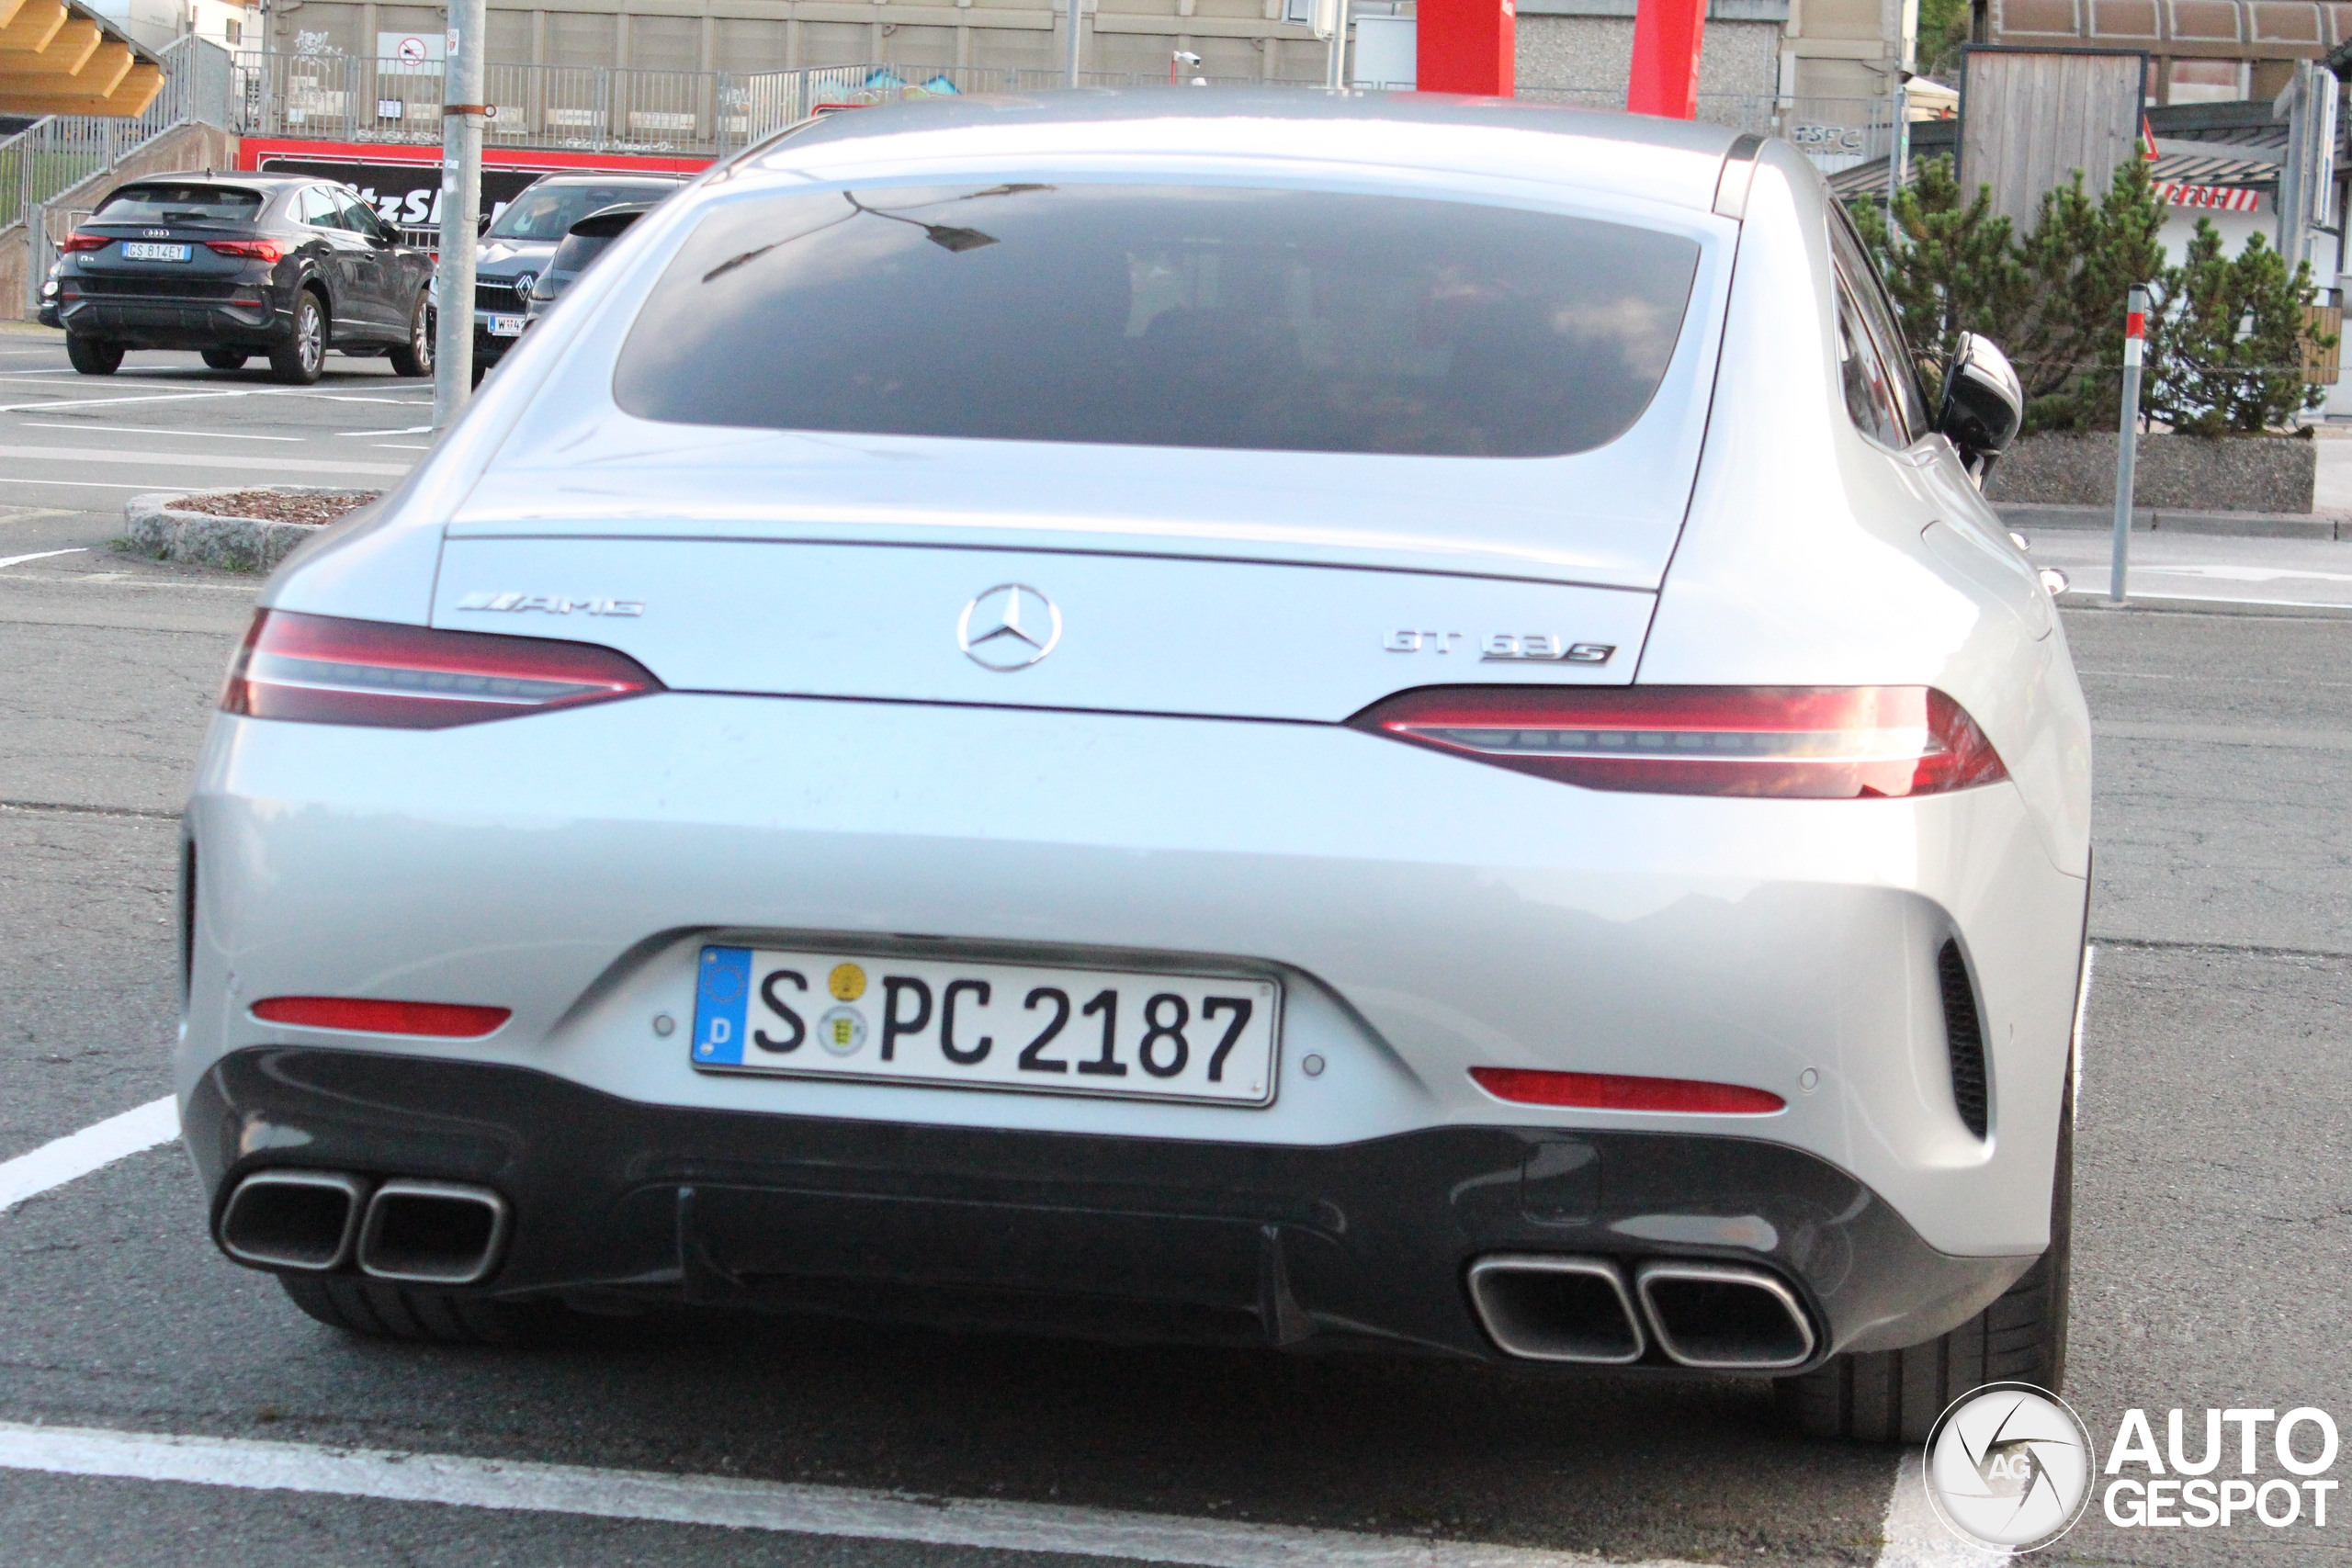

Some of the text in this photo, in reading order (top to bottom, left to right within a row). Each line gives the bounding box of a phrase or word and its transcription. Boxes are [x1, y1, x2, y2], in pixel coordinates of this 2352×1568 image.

[130, 244, 144, 257] GS
[147, 245, 184, 259] 814EY
[1384, 629, 1464, 654] GT
[753, 970, 1253, 1082] S PC 2187
